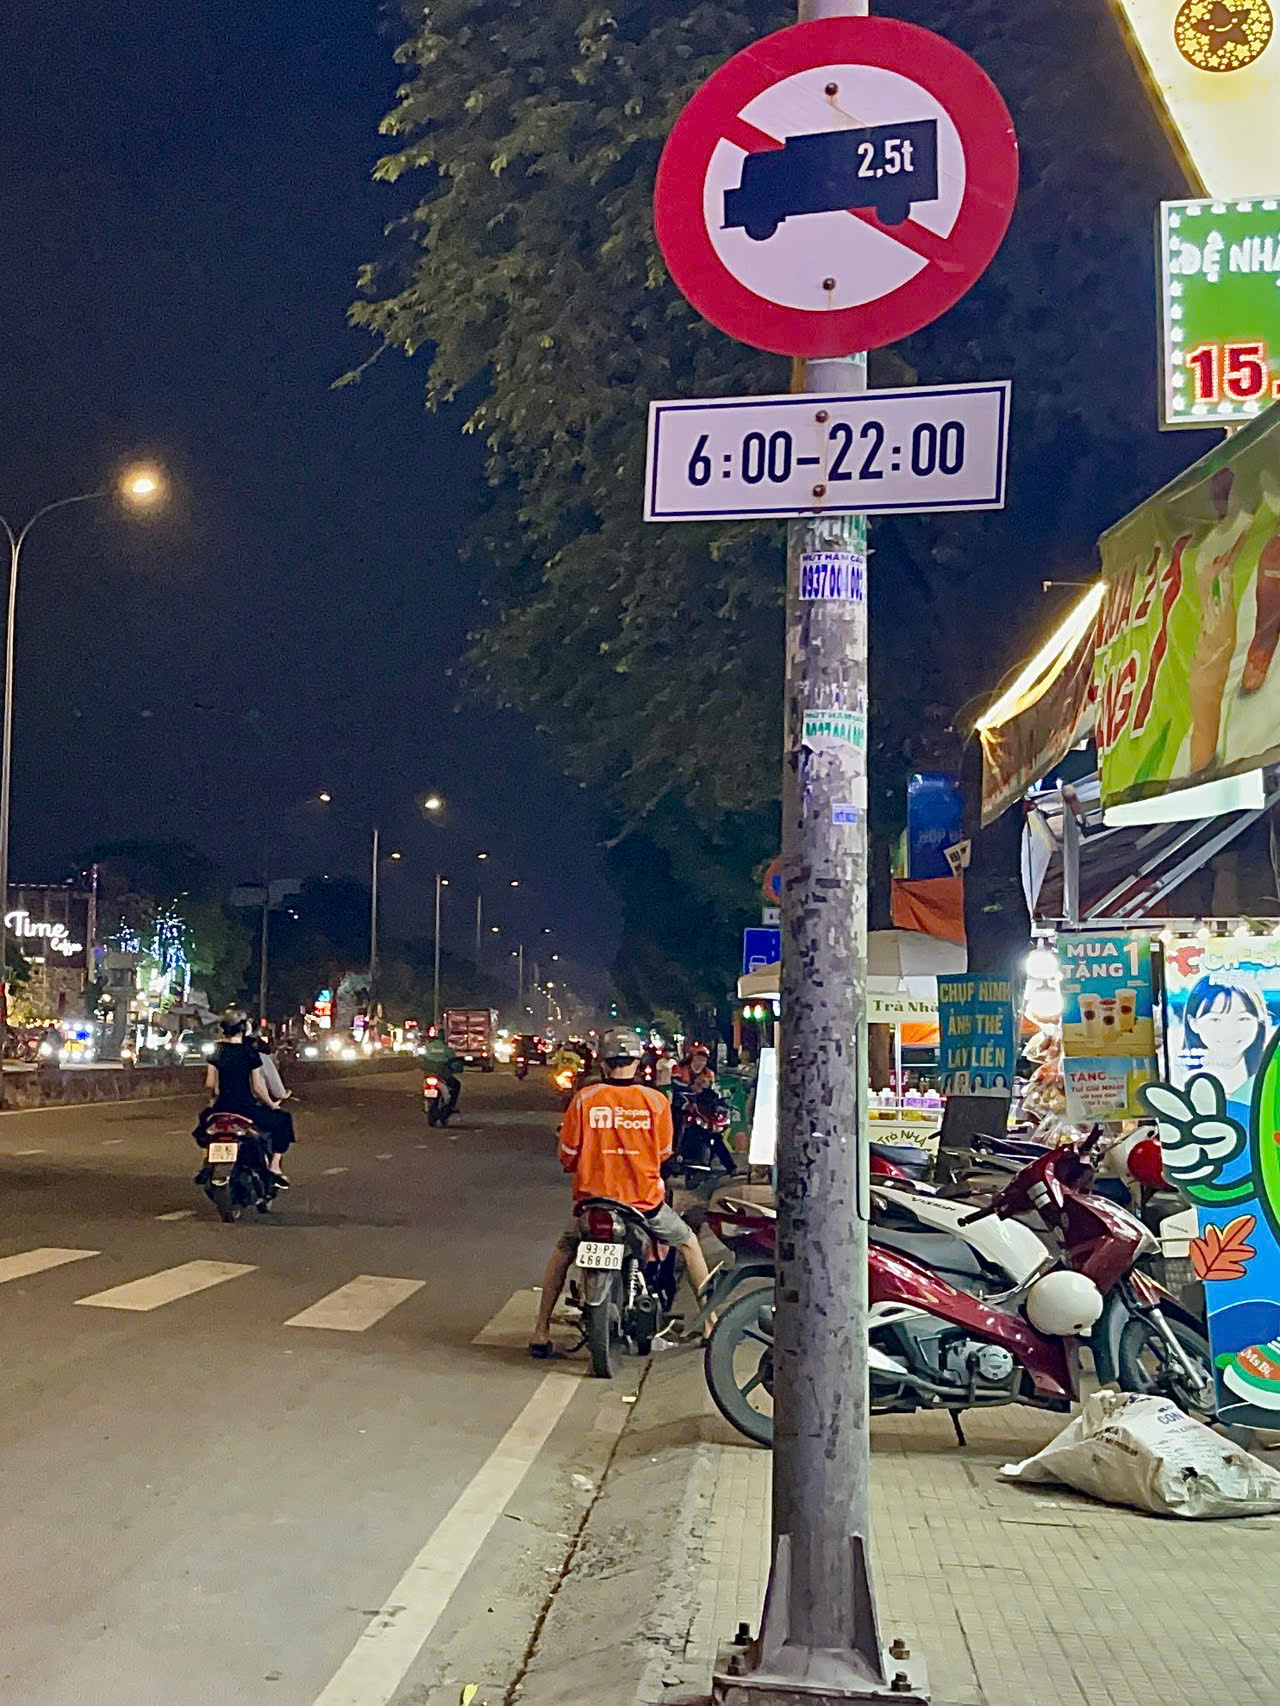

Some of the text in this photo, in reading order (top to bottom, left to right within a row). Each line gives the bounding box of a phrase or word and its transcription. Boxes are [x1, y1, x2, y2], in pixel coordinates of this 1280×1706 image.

[857, 139, 914, 178] 2,5t
[3, 910, 70, 938] Time
[1066, 942, 1119, 958] MUA
[1062, 959, 1125, 983] TẶNG
[614, 1116, 652, 1130] Food
